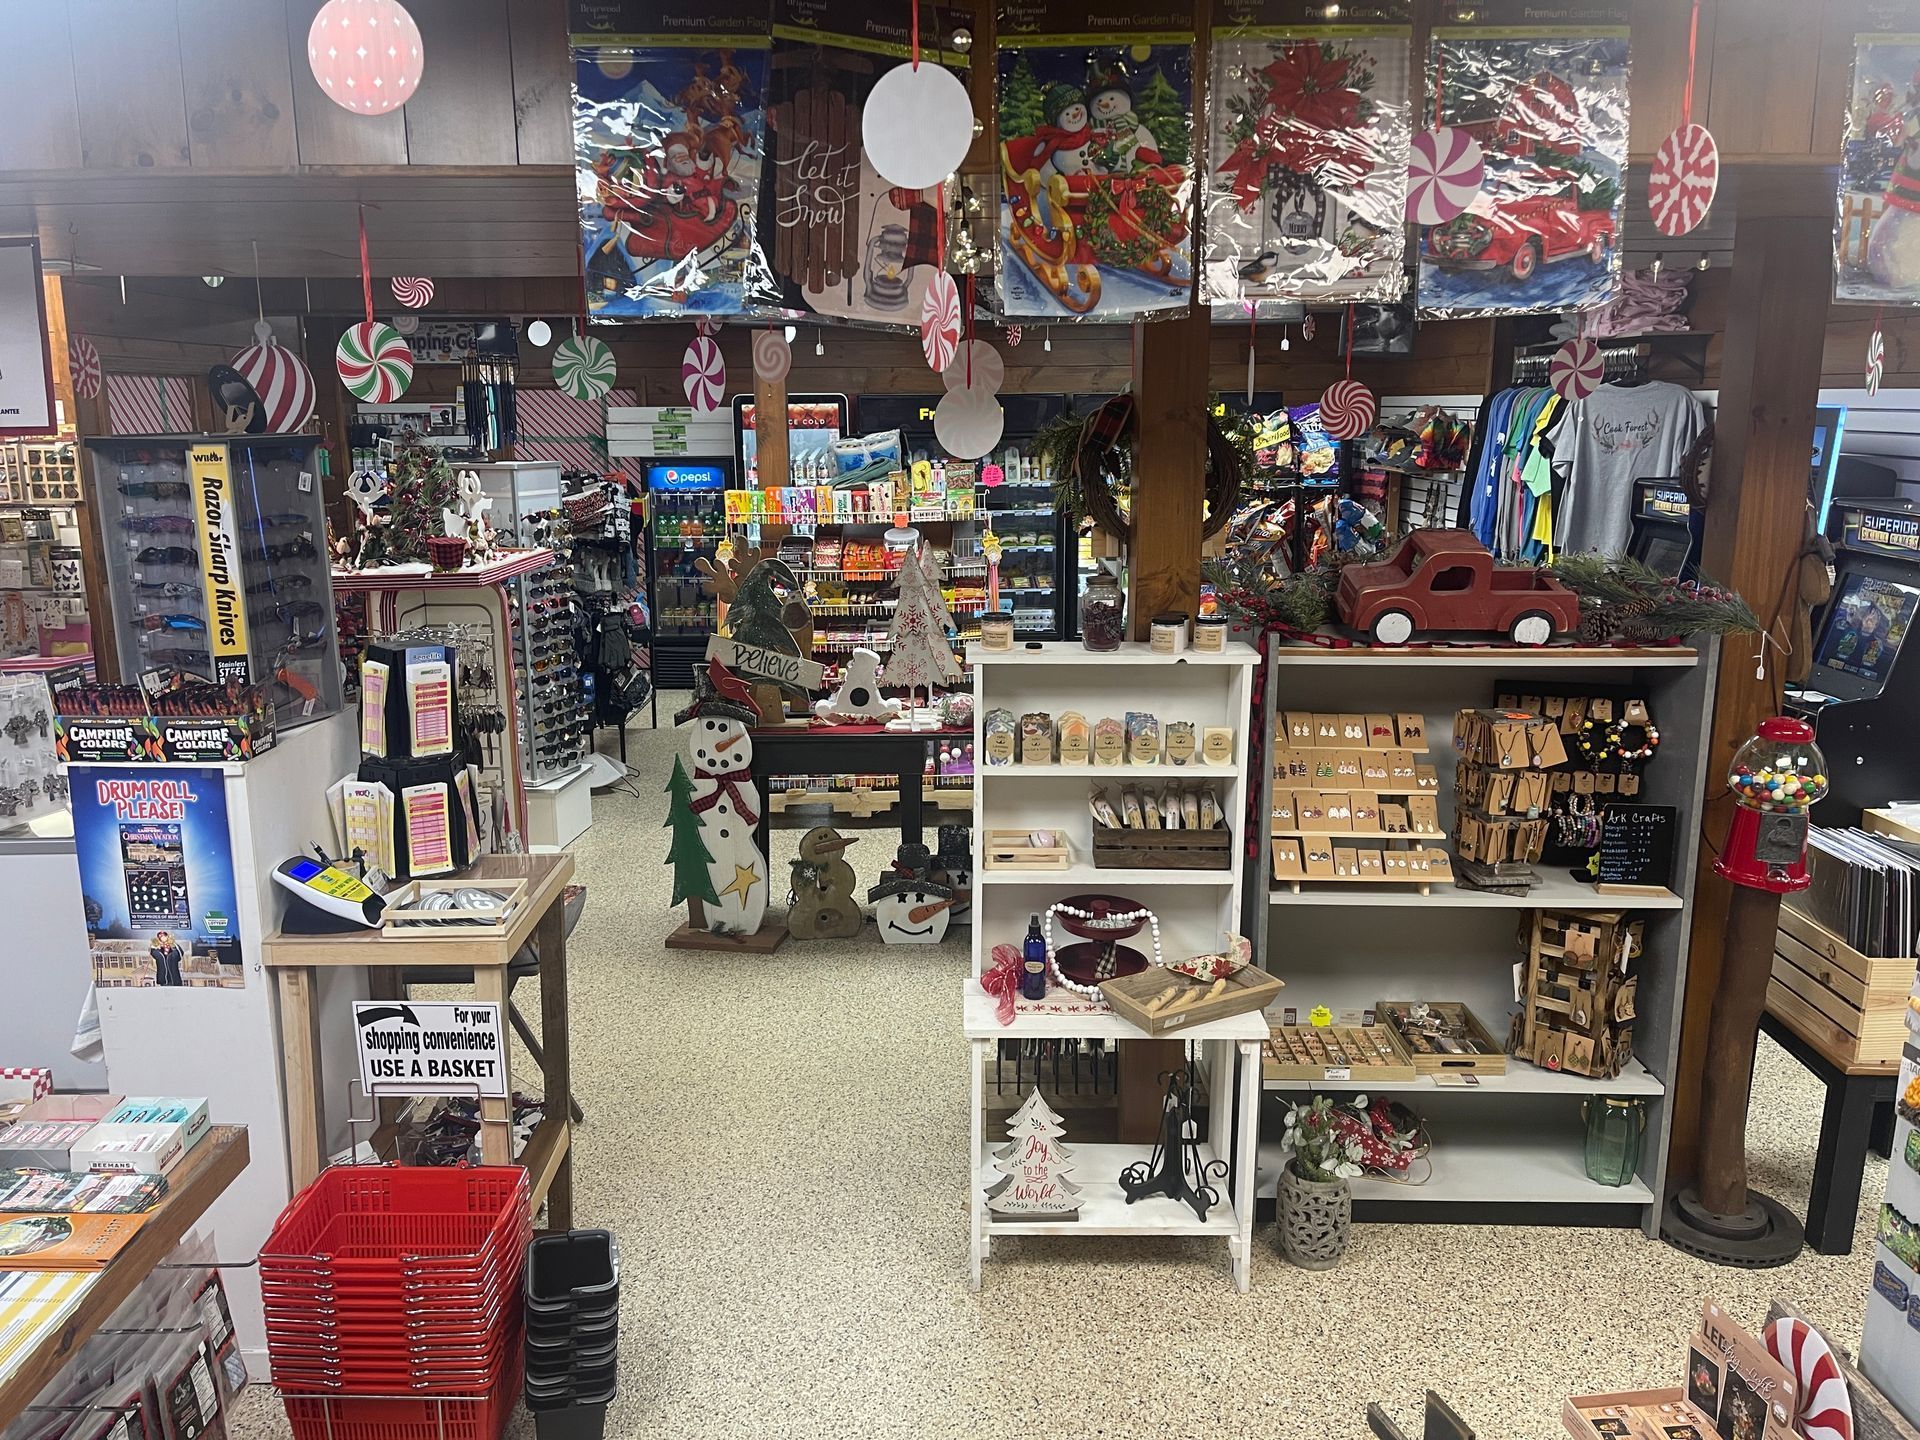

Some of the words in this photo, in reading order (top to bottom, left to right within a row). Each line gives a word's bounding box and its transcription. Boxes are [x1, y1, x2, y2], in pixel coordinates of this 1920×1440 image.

[662, 15, 706, 28] Premium
[707, 16, 744, 28] Garden
[746, 17, 768, 29] Flag
[865, 19, 908, 38] Premium
[1087, 15, 1131, 26] Premium
[1132, 15, 1169, 26] Garden
[404, 333, 450, 354] mping
[1603, 422, 1623, 435] Cook
[1624, 420, 1649, 434] Forest
[680, 471, 712, 485] pepsi
[202, 477, 223, 528] Razor
[1865, 515, 1919, 535] SUPERIOR
[1862, 528, 1889, 543] SKILL
[1890, 533, 1919, 549] GAMES
[208, 530, 231, 585] Sharp
[214, 589, 239, 647] Knives
[218, 660, 246, 669] Stainless
[732, 644, 799, 681] Believe
[70, 726, 133, 742] CAMPFIRE
[165, 727, 229, 742] CAMPFIRE
[80, 739, 128, 749] COLORS
[175, 740, 224, 750] COLORS
[97, 780, 147, 805] DRUM
[150, 780, 197, 803] ROLL,
[115, 799, 185, 820] PLEASE!
[1631, 813, 1666, 824] Crafts
[454, 1007, 469, 1024] For
[471, 1010, 491, 1027] your
[365, 1026, 420, 1055] shopping
[422, 1026, 496, 1051] convenience
[370, 1059, 405, 1078] USE
[410, 1059, 423, 1078] A
[428, 1059, 496, 1078] BASKET
[1025, 1134, 1056, 1164] Joy
[1023, 1165, 1032, 1176] to
[1034, 1163, 1048, 1176] the
[1011, 1183, 1060, 1203] World
